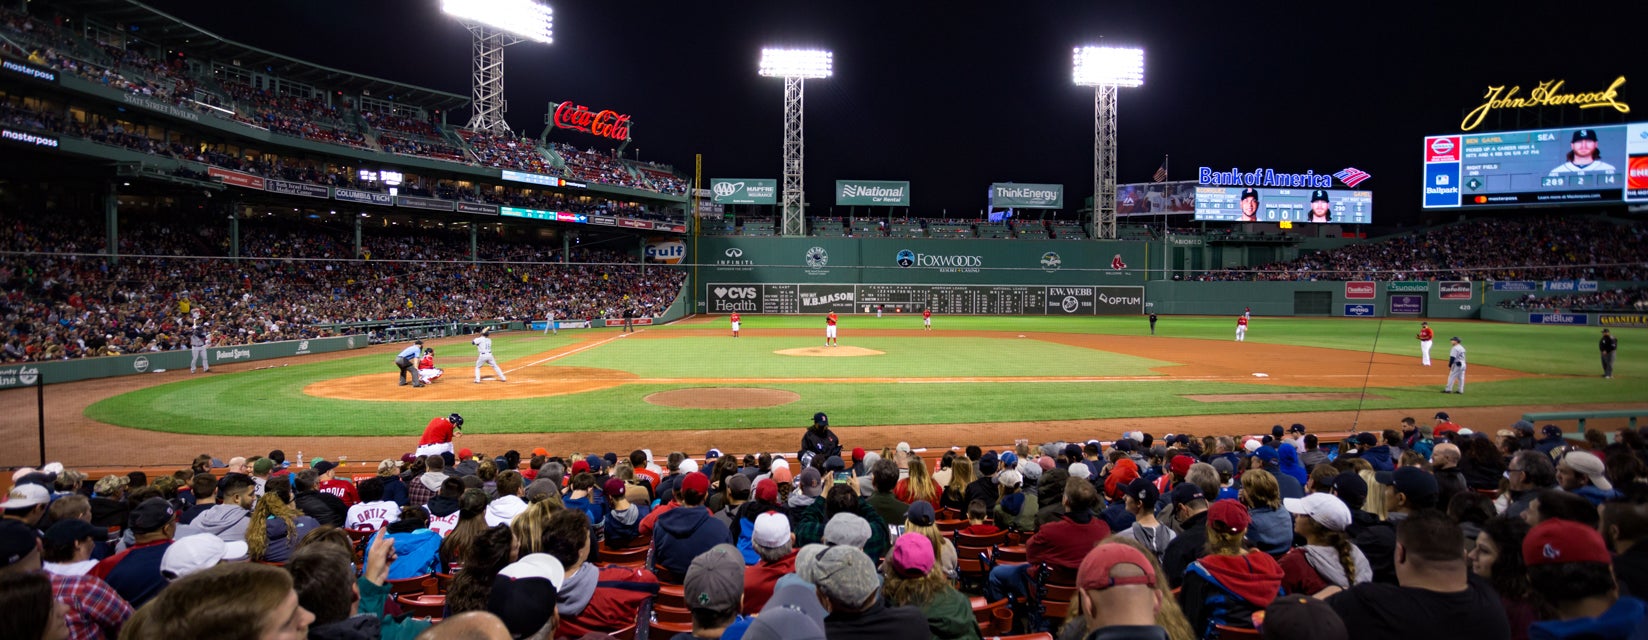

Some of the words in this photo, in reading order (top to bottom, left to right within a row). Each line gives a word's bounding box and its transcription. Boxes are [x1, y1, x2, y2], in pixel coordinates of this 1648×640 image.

[3, 61, 55, 80] masterpass
[123, 93, 144, 105] STATE
[144, 99, 169, 112] STREET
[169, 105, 199, 121] PAVILION
[1461, 85, 1524, 131] John
[1523, 76, 1631, 113] Hancock
[2, 130, 58, 147] masterpass
[1537, 133, 1555, 141] SEA
[1199, 166, 1243, 186] Bank
[1245, 168, 1264, 186] of
[1264, 169, 1332, 188] America
[1542, 178, 1564, 186] .289
[1578, 177, 1584, 185] 2
[1605, 176, 1615, 184] 14
[276, 186, 295, 194] Medical
[296, 188, 312, 196] Center
[336, 189, 371, 201] COLUMBIA
[372, 194, 390, 202] TECH
[857, 186, 903, 198] National
[996, 188, 1057, 201] ThinkEnergy
[1268, 210, 1275, 219] 0
[1282, 210, 1289, 219] 0
[1296, 210, 1300, 220] 1
[645, 244, 683, 257] Gulf
[917, 254, 982, 267] FOXWOODS
[1550, 282, 1574, 290] NESN
[728, 287, 757, 299] CVS
[715, 300, 757, 311] Health
[1109, 296, 1140, 305] OPTUM
[1542, 314, 1573, 324] jetBlue
[1601, 315, 1639, 324] GRANITE
[216, 350, 234, 360] Poland
[234, 349, 250, 360] Spring
[357, 508, 388, 523] ORTIZ
